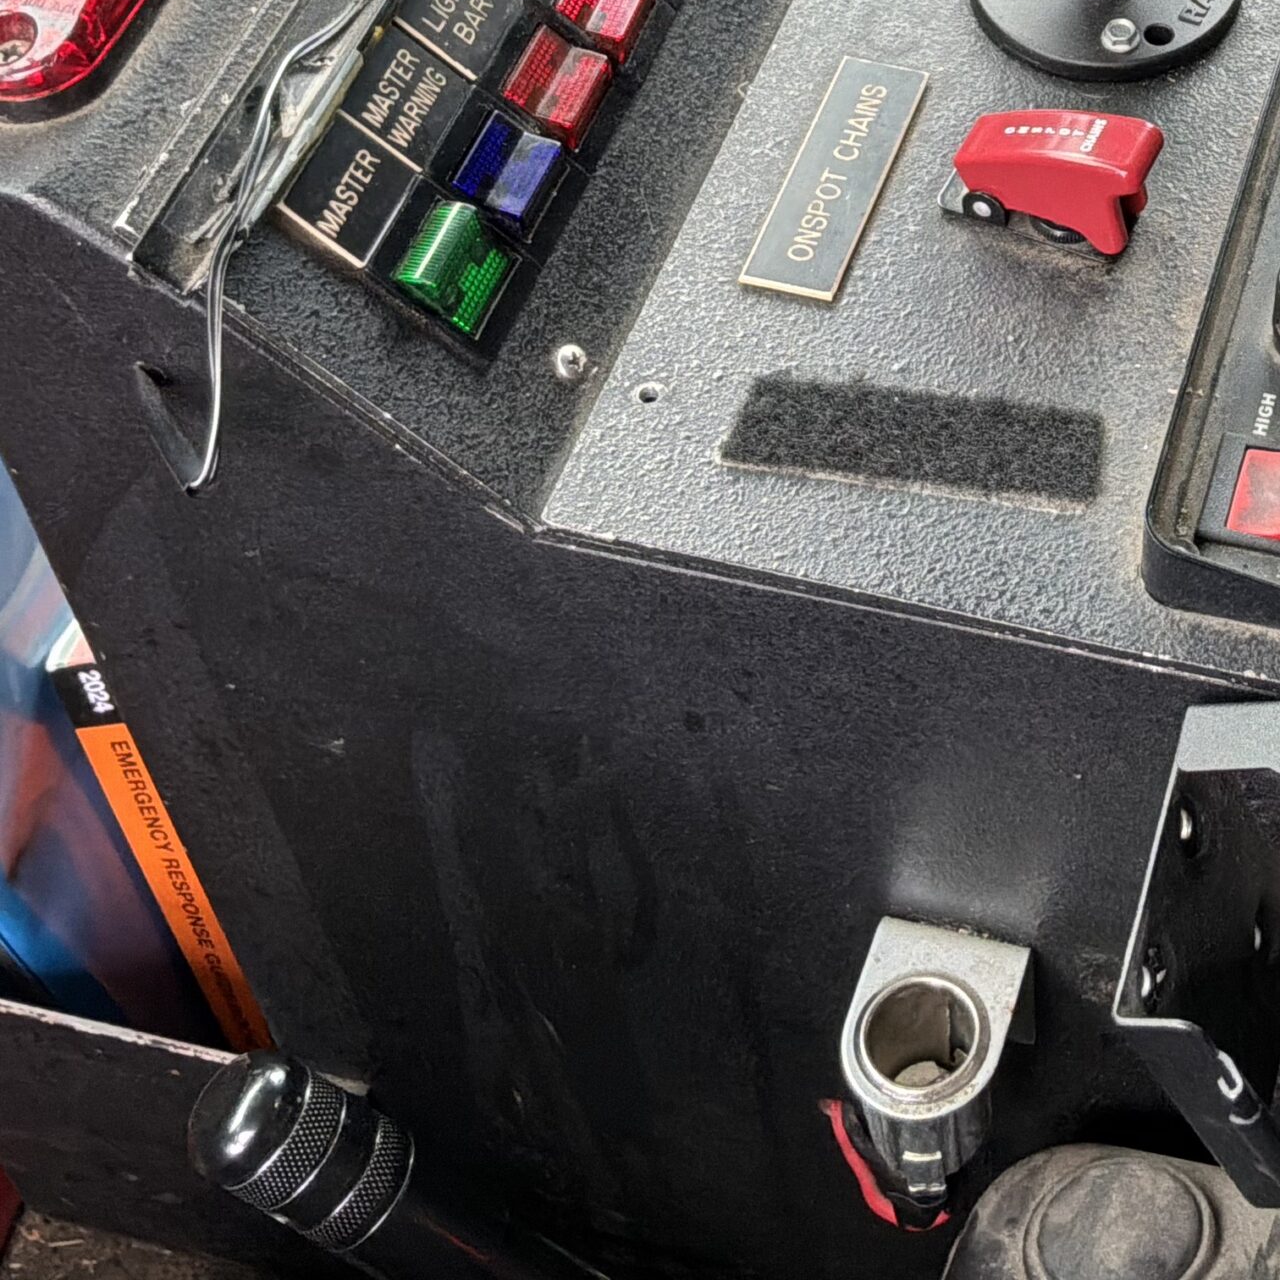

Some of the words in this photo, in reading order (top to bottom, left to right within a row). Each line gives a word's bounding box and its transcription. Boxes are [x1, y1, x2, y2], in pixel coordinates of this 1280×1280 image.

[362, 48, 420, 128] MASTER
[387, 67, 447, 148] WARNING
[316, 148, 381, 238] MASTER
[787, 166, 848, 262] ONSPOT
[833, 84, 887, 161] CHAINS
[1253, 392, 1277, 437] HIGH
[77, 669, 114, 713] 2024
[110, 739, 173, 852] EMERGENCY
[162, 856, 215, 949] RESPONSE
